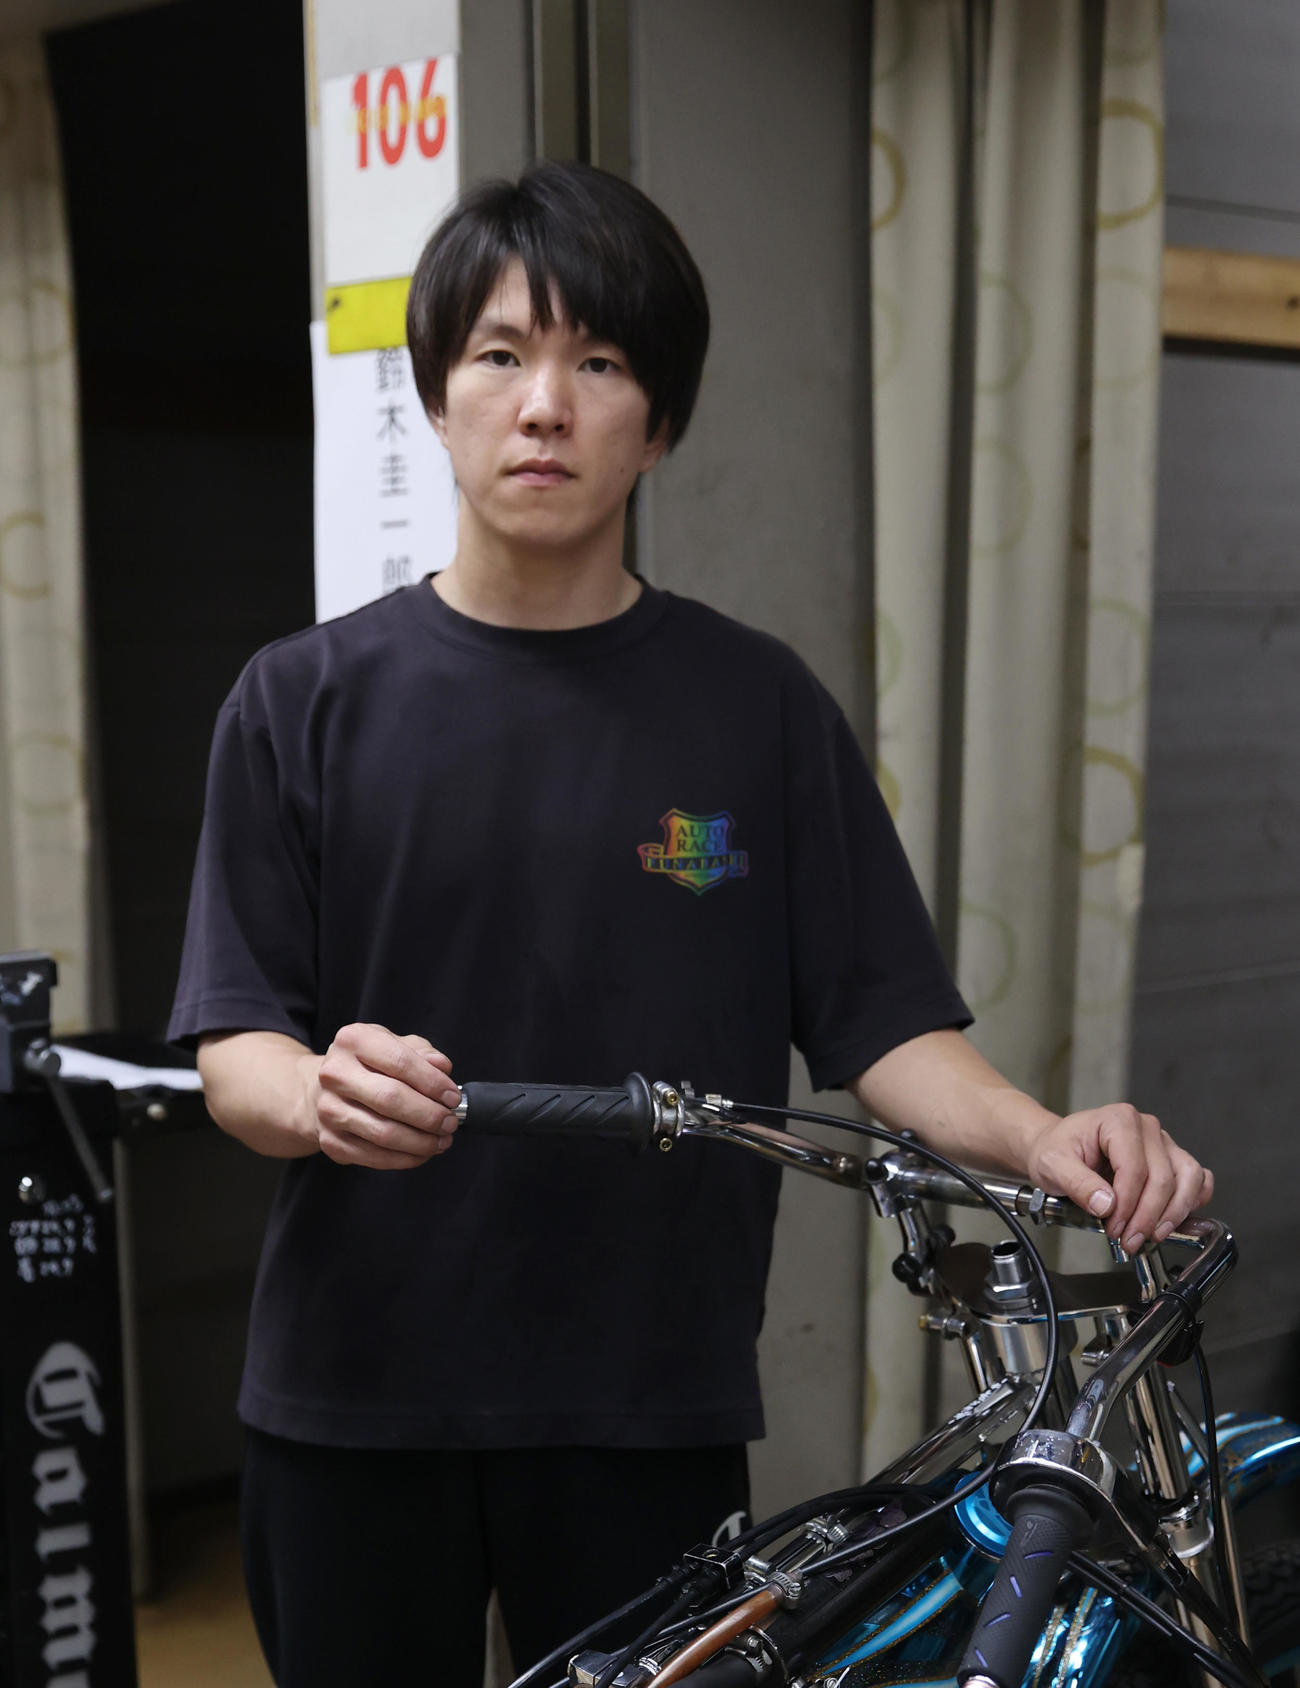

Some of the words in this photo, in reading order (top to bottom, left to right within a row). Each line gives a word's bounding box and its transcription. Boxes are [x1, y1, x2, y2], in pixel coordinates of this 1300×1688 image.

[352, 58, 447, 169] 106
[676, 824, 725, 838] AUTO
[676, 839, 722, 853] RACE
